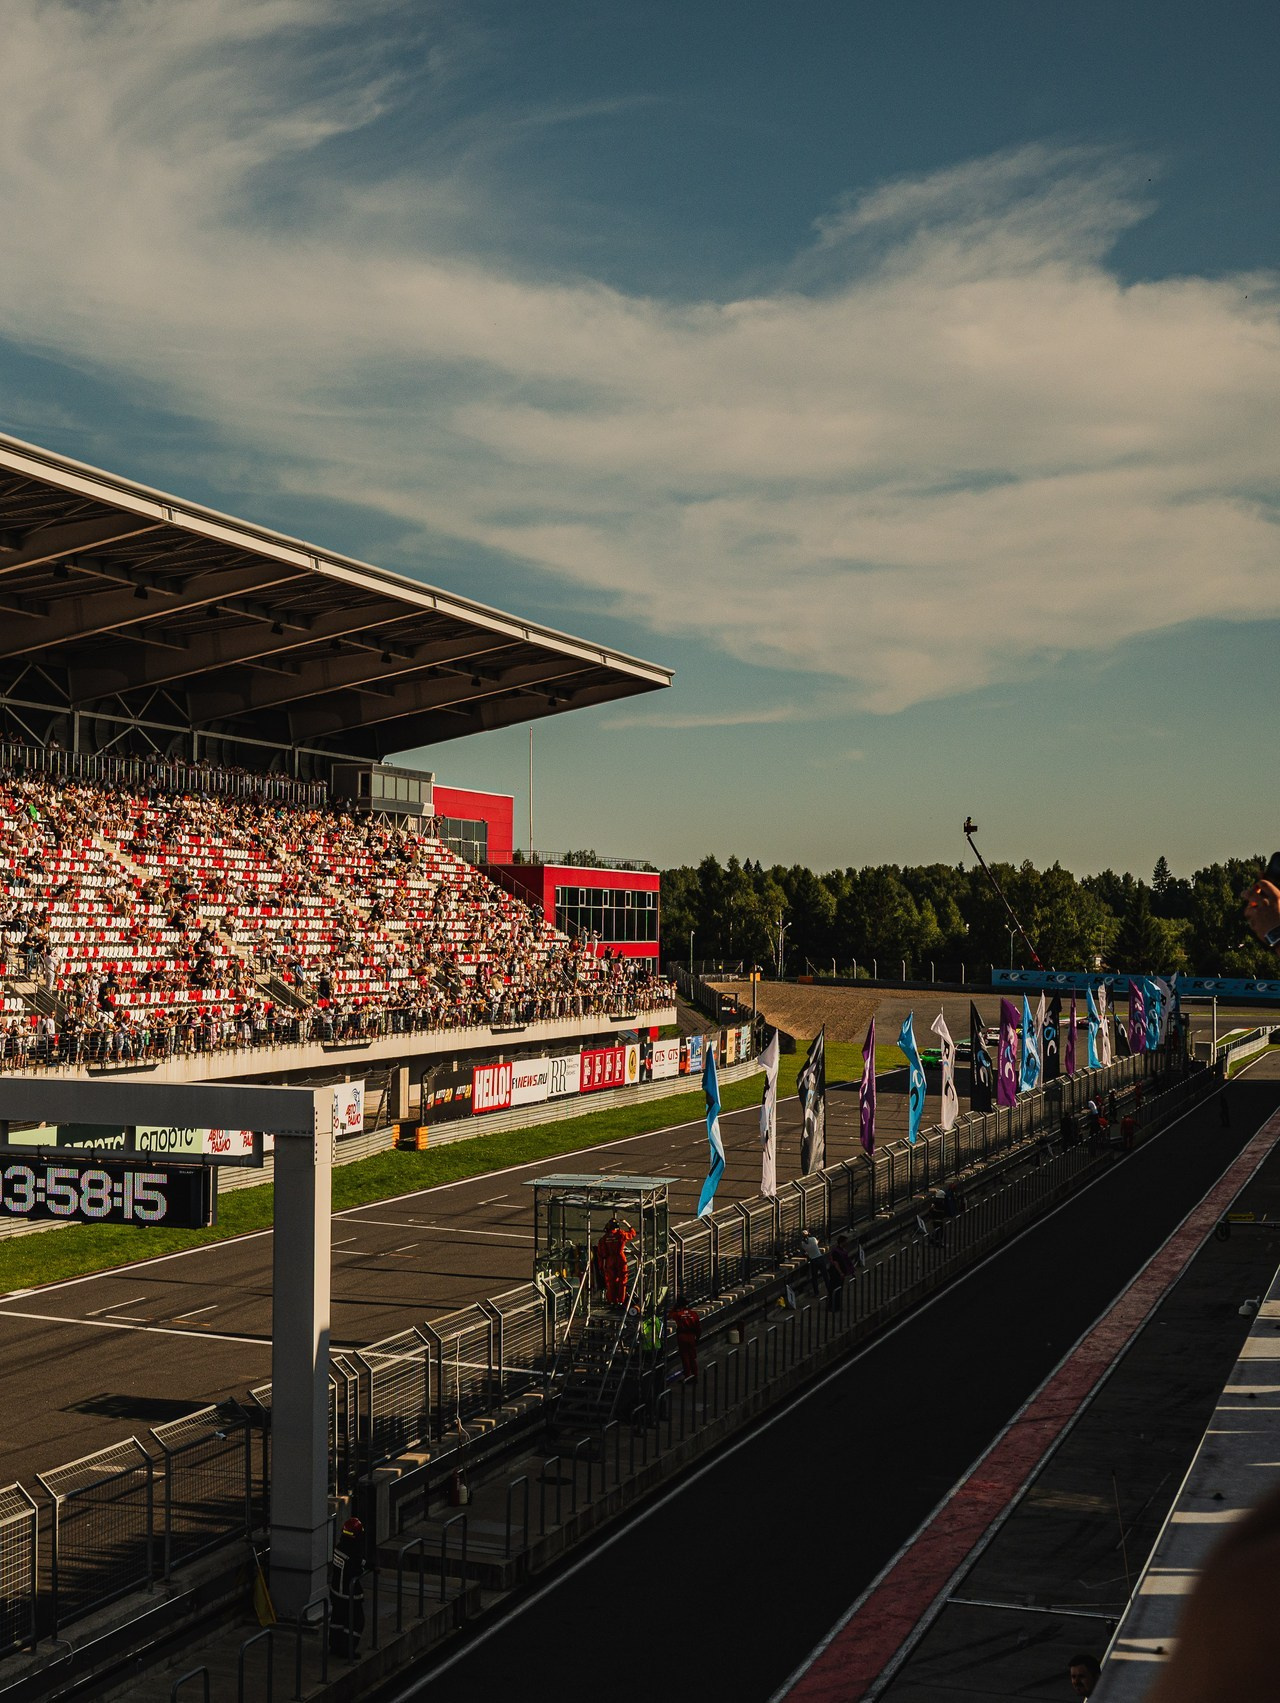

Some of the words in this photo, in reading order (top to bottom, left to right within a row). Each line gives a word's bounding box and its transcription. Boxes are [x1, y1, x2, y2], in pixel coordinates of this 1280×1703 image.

[474, 1066, 511, 1110] HELLO!
[511, 1073, 548, 1090] F1NEWS.RU
[550, 1059, 567, 1094] RR
